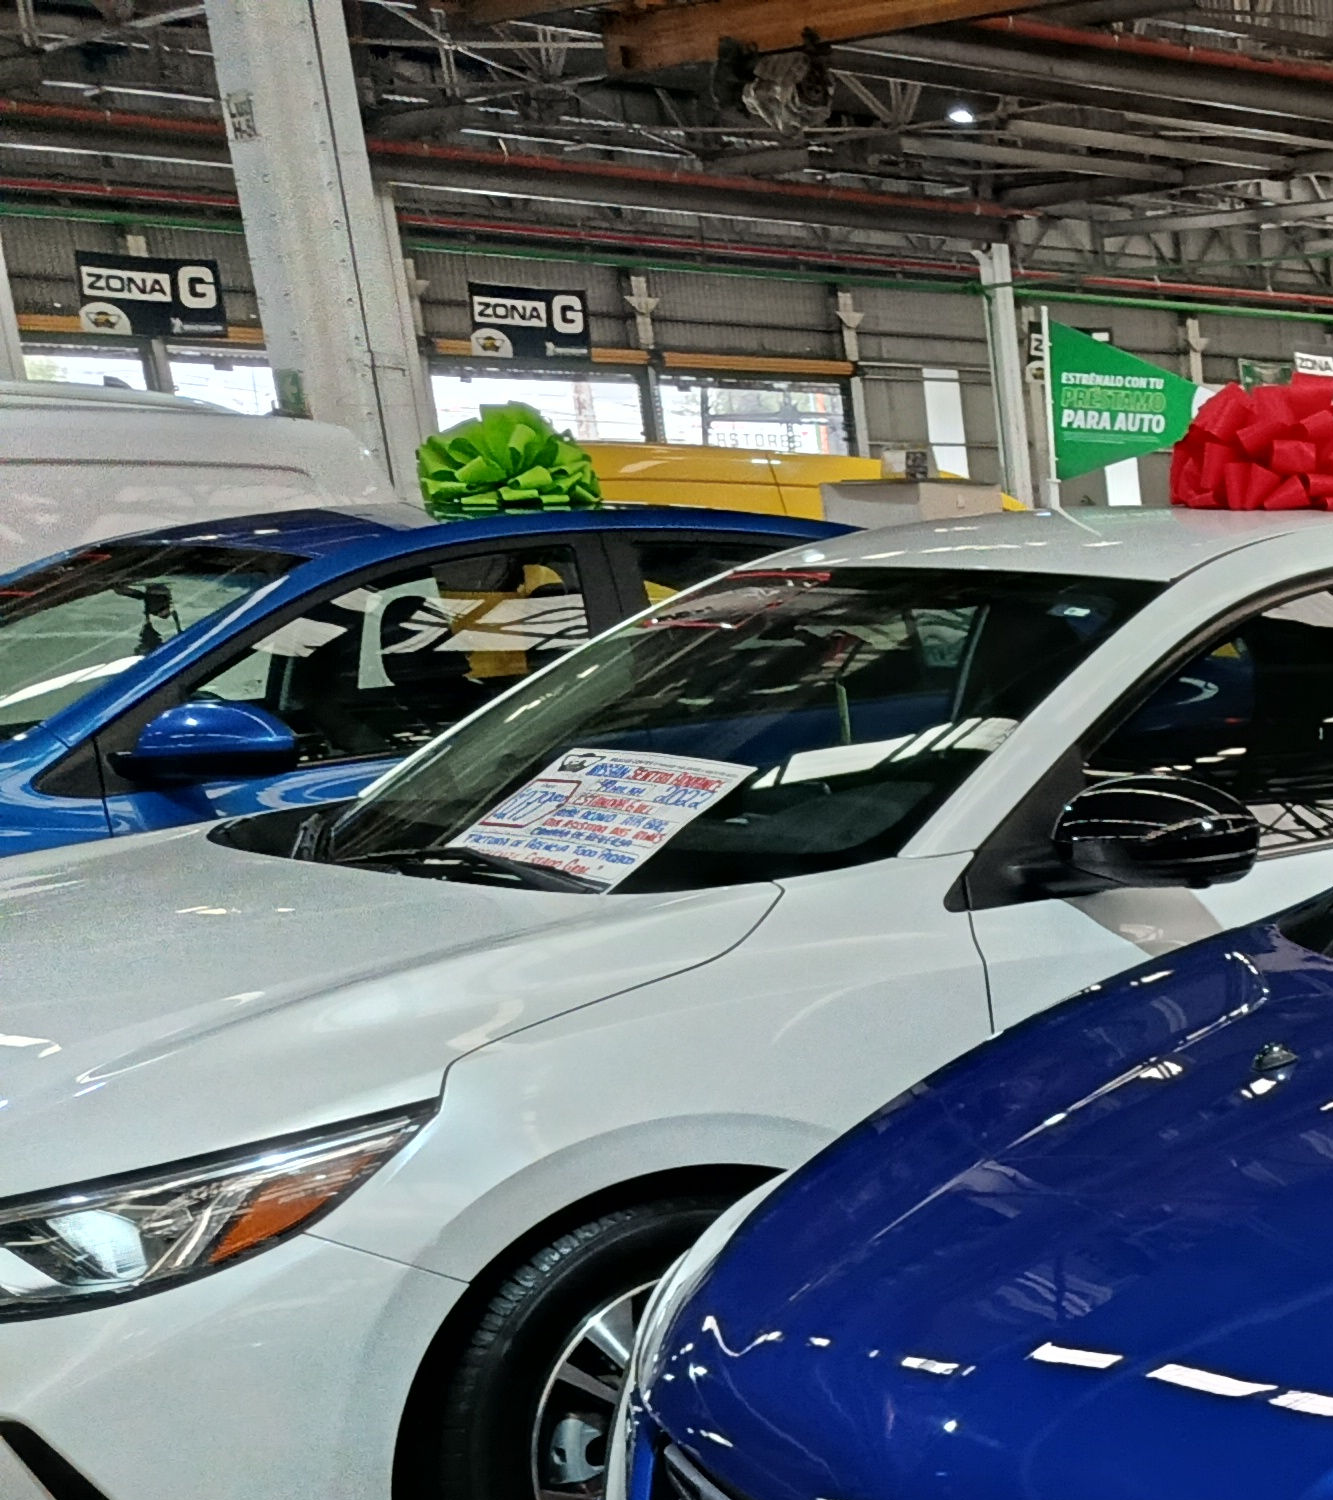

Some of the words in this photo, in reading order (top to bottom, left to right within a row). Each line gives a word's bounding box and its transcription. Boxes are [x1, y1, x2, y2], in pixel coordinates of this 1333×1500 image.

[86, 273, 167, 297] ZONA
[178, 265, 217, 309] G
[477, 302, 543, 323] ZONA
[552, 294, 584, 334] G
[1061, 372, 1123, 388] ESTRÉNALO
[1124, 375, 1147, 389] CON
[1148, 378, 1164, 389] TU
[1060, 386, 1166, 412] PRÉSTAMO
[1060, 409, 1112, 430] PARA
[1114, 411, 1166, 433] AUTO
